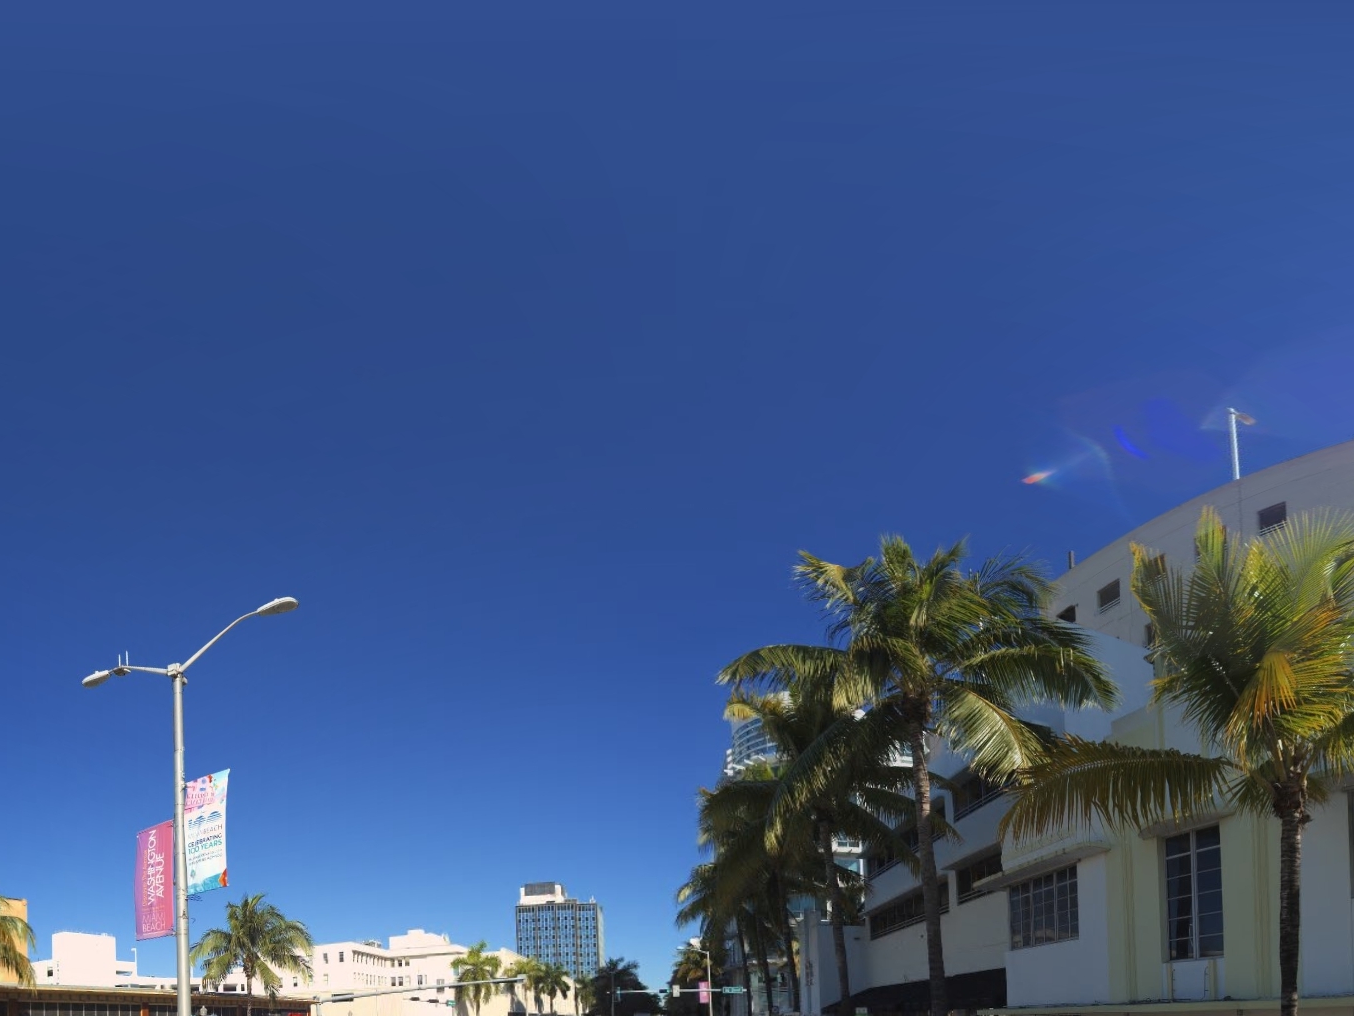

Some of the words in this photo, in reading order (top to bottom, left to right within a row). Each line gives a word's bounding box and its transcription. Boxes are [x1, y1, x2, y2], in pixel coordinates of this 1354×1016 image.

[188, 832, 222, 848] CELEBRATING
[188, 845, 199, 855] 100
[201, 839, 223, 850] YEARS
[147, 829, 157, 906] WASHINGTON
[155, 852, 165, 898] AVENUE
[142, 920, 166, 933] BEACH
